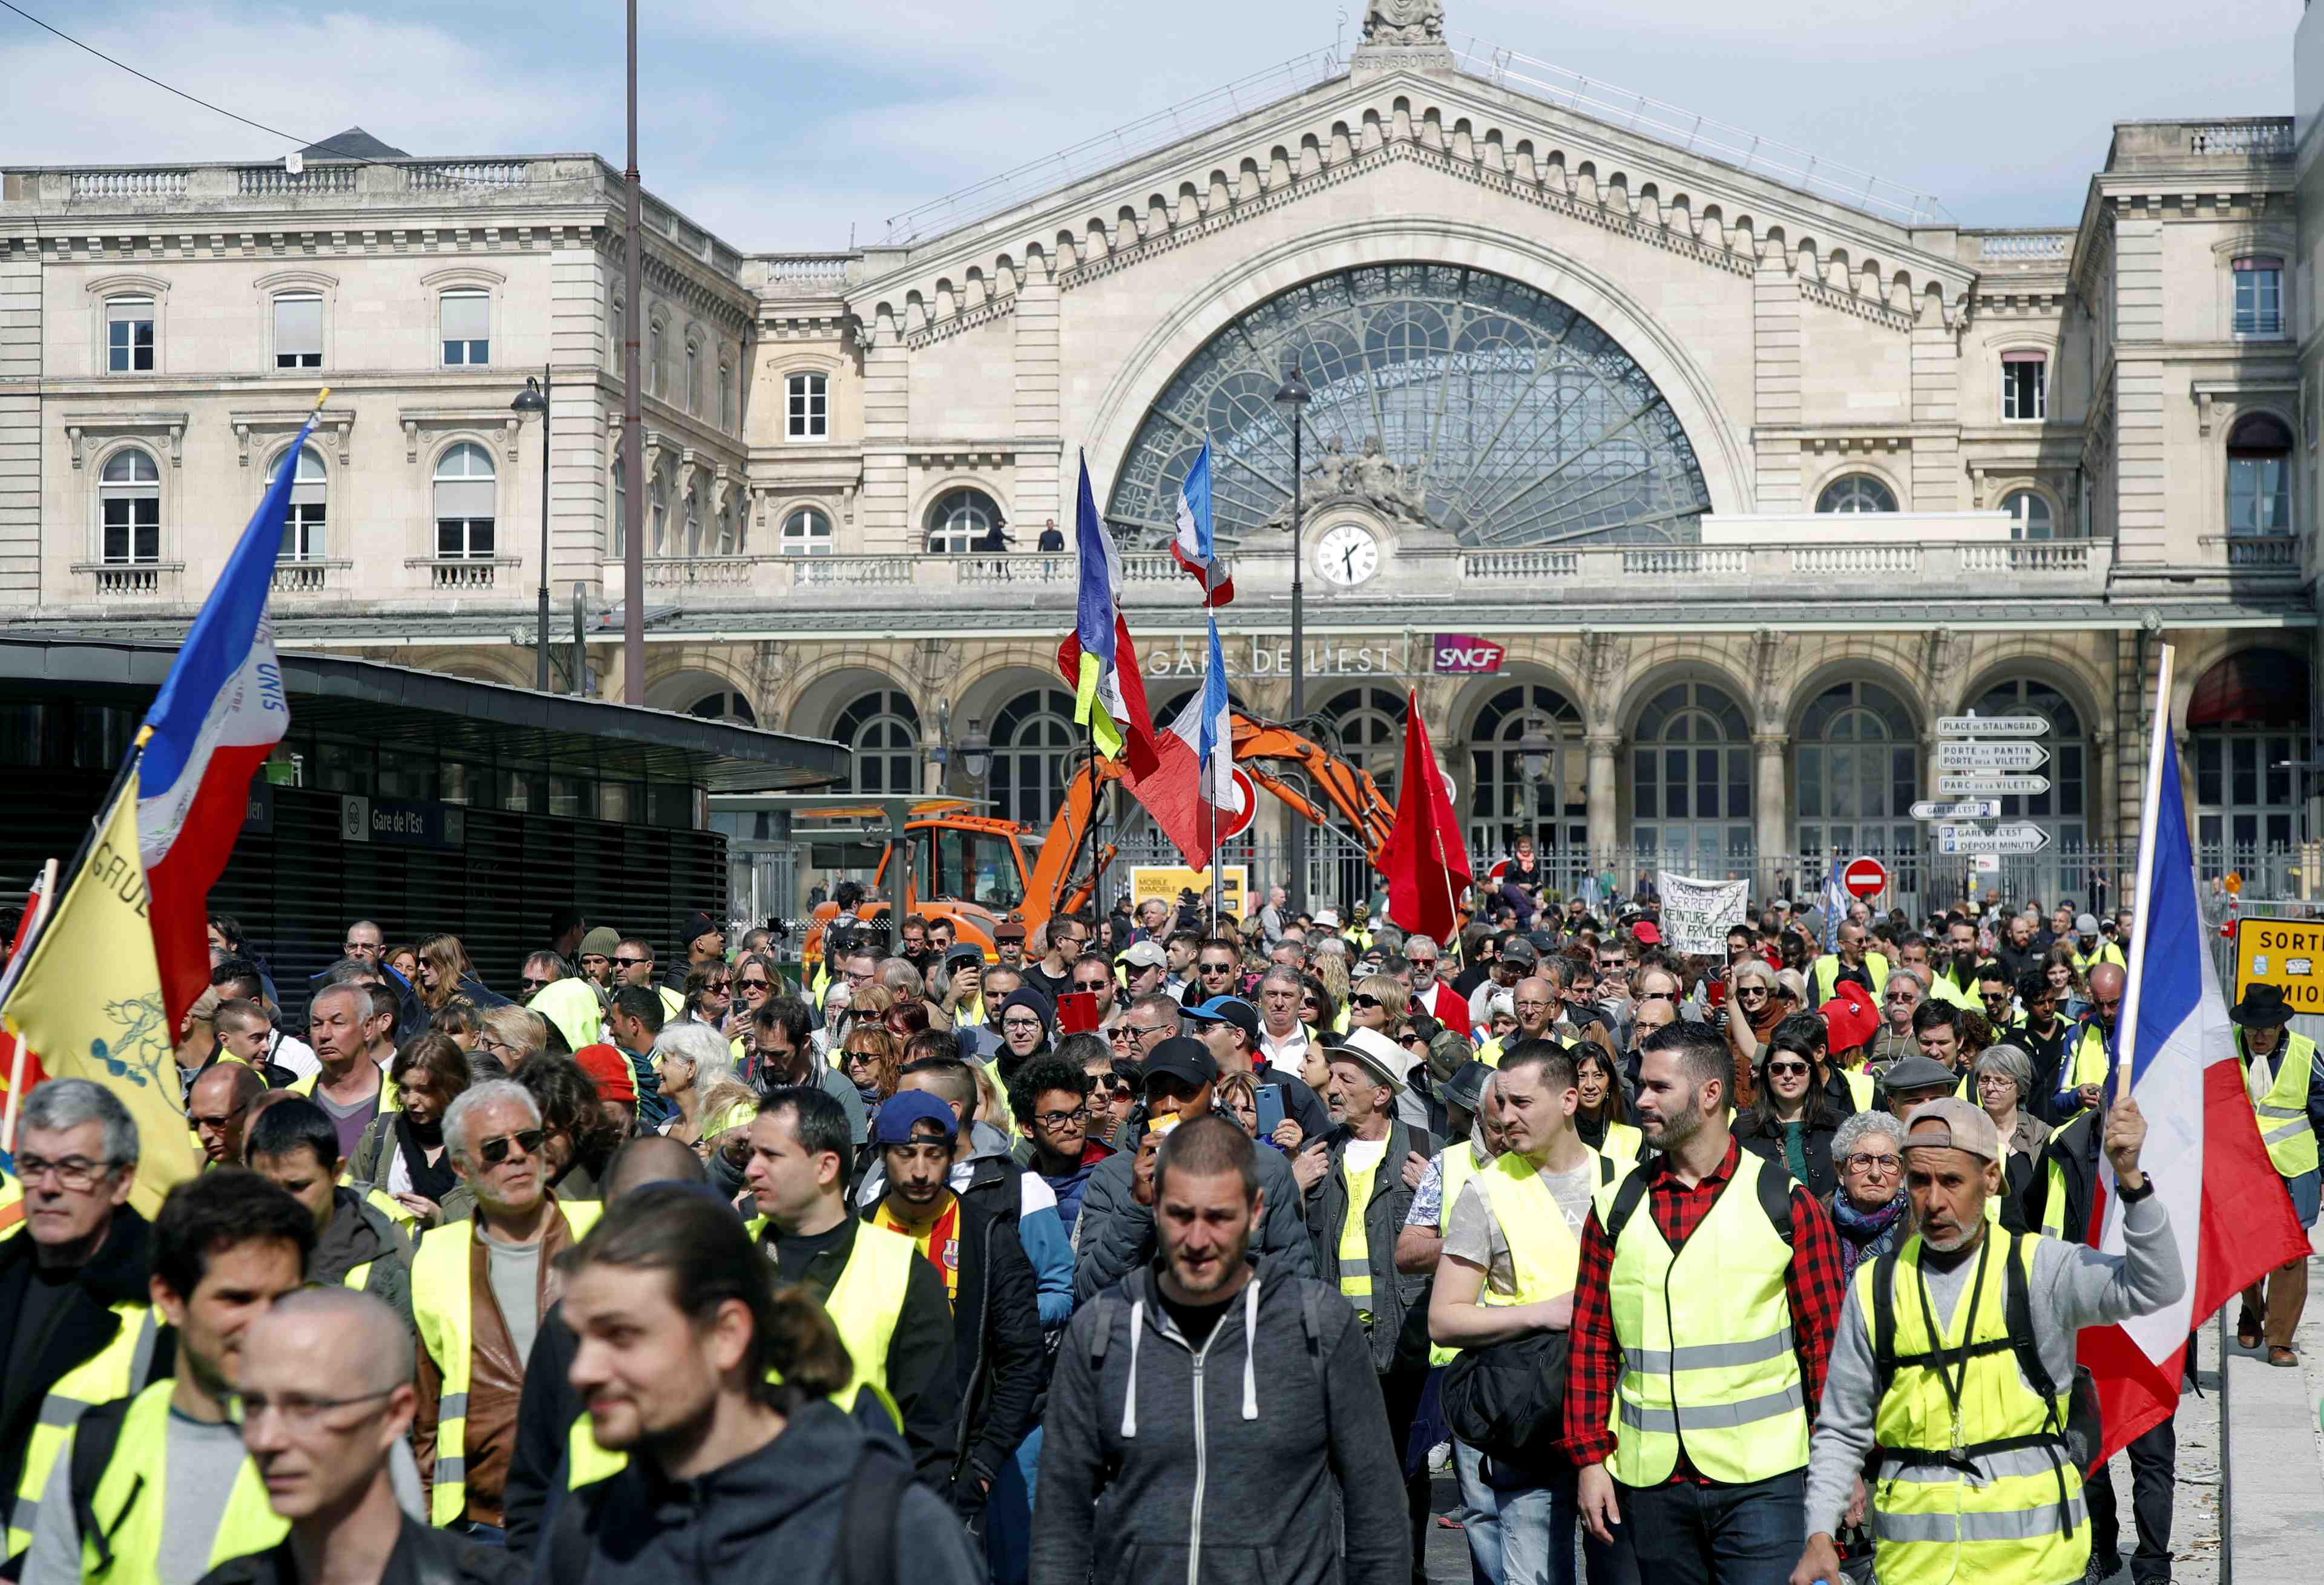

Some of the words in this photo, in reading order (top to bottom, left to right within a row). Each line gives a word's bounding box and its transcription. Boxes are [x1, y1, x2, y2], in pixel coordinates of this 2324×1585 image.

[1254, 649, 1292, 674] DE
[1436, 648, 1501, 667] SNCF
[257, 663, 286, 712] UNIS
[1943, 722, 1972, 730] PLACE
[1983, 722, 2037, 730] STALINGRAD
[1945, 747, 1977, 755] PORTE
[1994, 747, 2032, 755] PANTIN
[1945, 781, 1970, 789] PARC
[1927, 806, 1945, 814] GARE
[373, 809, 392, 831] Gare
[394, 810, 404, 832] de
[406, 810, 424, 833] l'Est
[1958, 829, 1981, 838] GARE
[1667, 882, 1705, 896] MARRE
[1712, 887, 1724, 898] DE
[1670, 896, 1714, 911] SERRER
[1715, 911, 1744, 924] FACE
